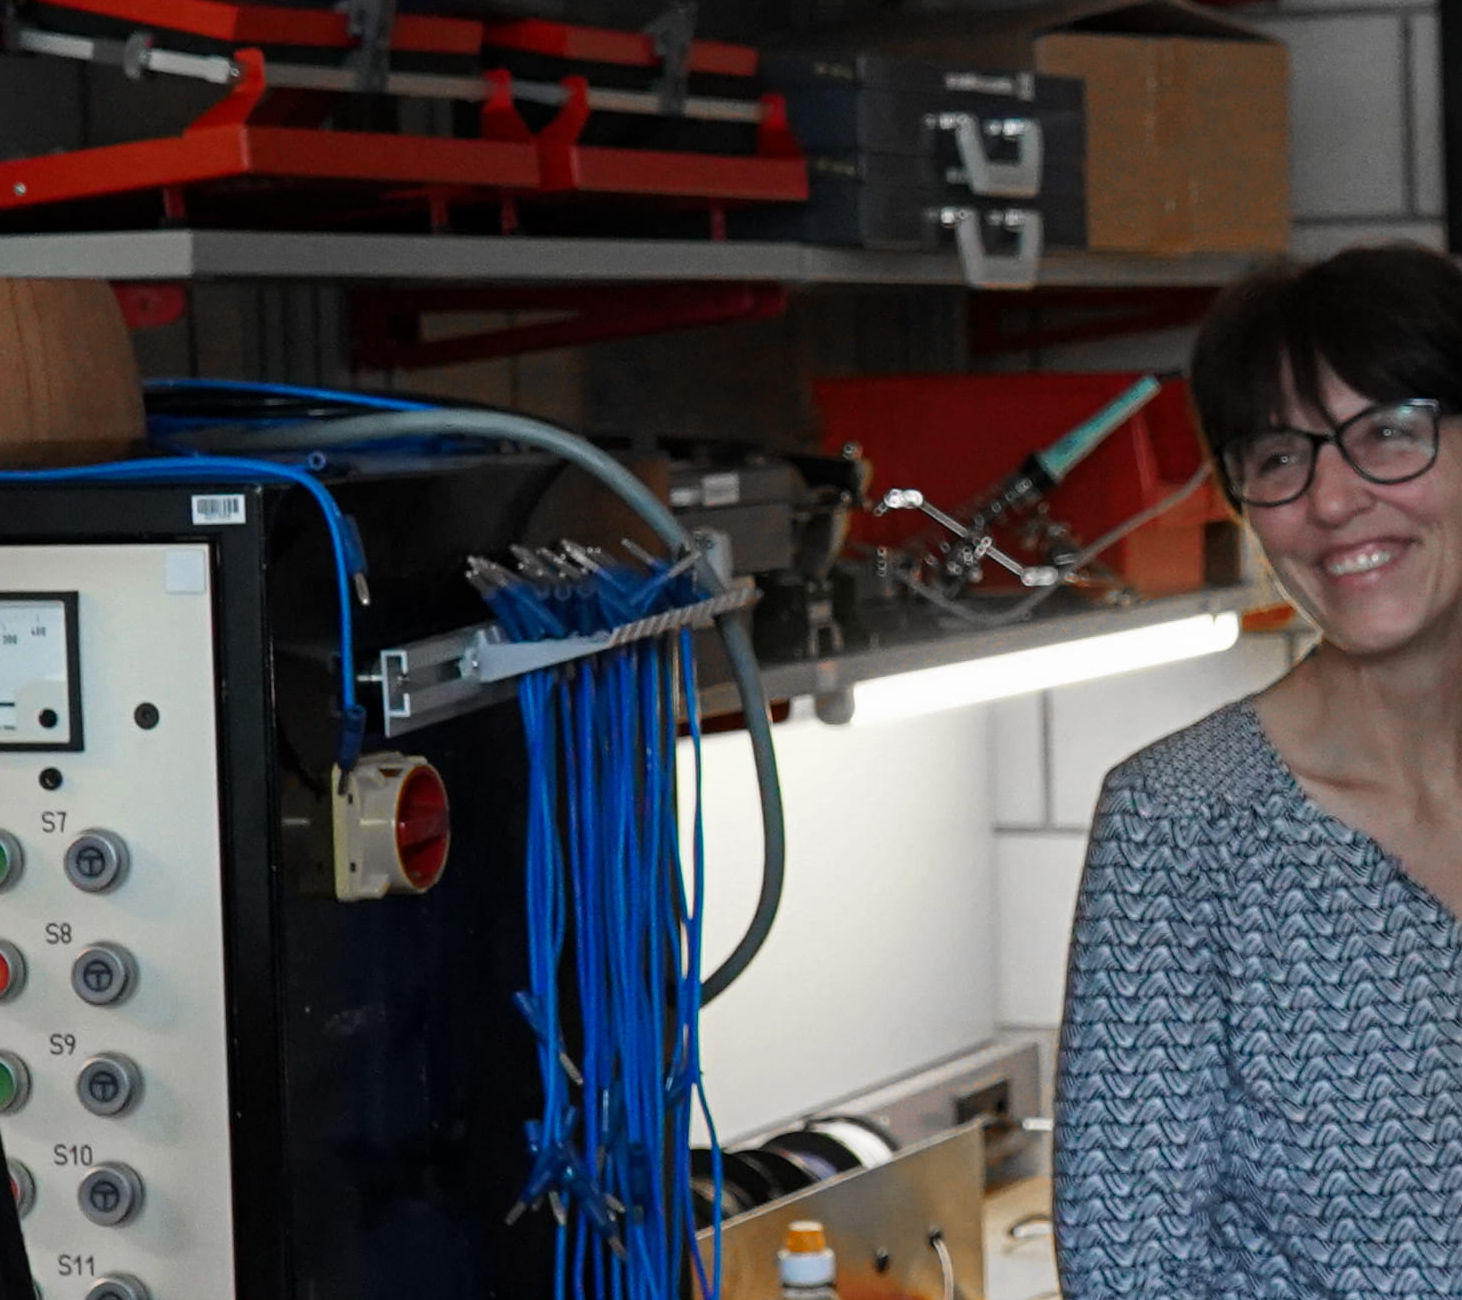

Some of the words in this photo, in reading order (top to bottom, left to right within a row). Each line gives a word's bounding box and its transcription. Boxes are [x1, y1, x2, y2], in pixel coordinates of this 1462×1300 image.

[41, 811, 67, 833] S7
[45, 922, 72, 944] S8
[49, 1033, 76, 1056] S9
[53, 1143, 93, 1166] S10
[58, 1254, 95, 1276] S11
